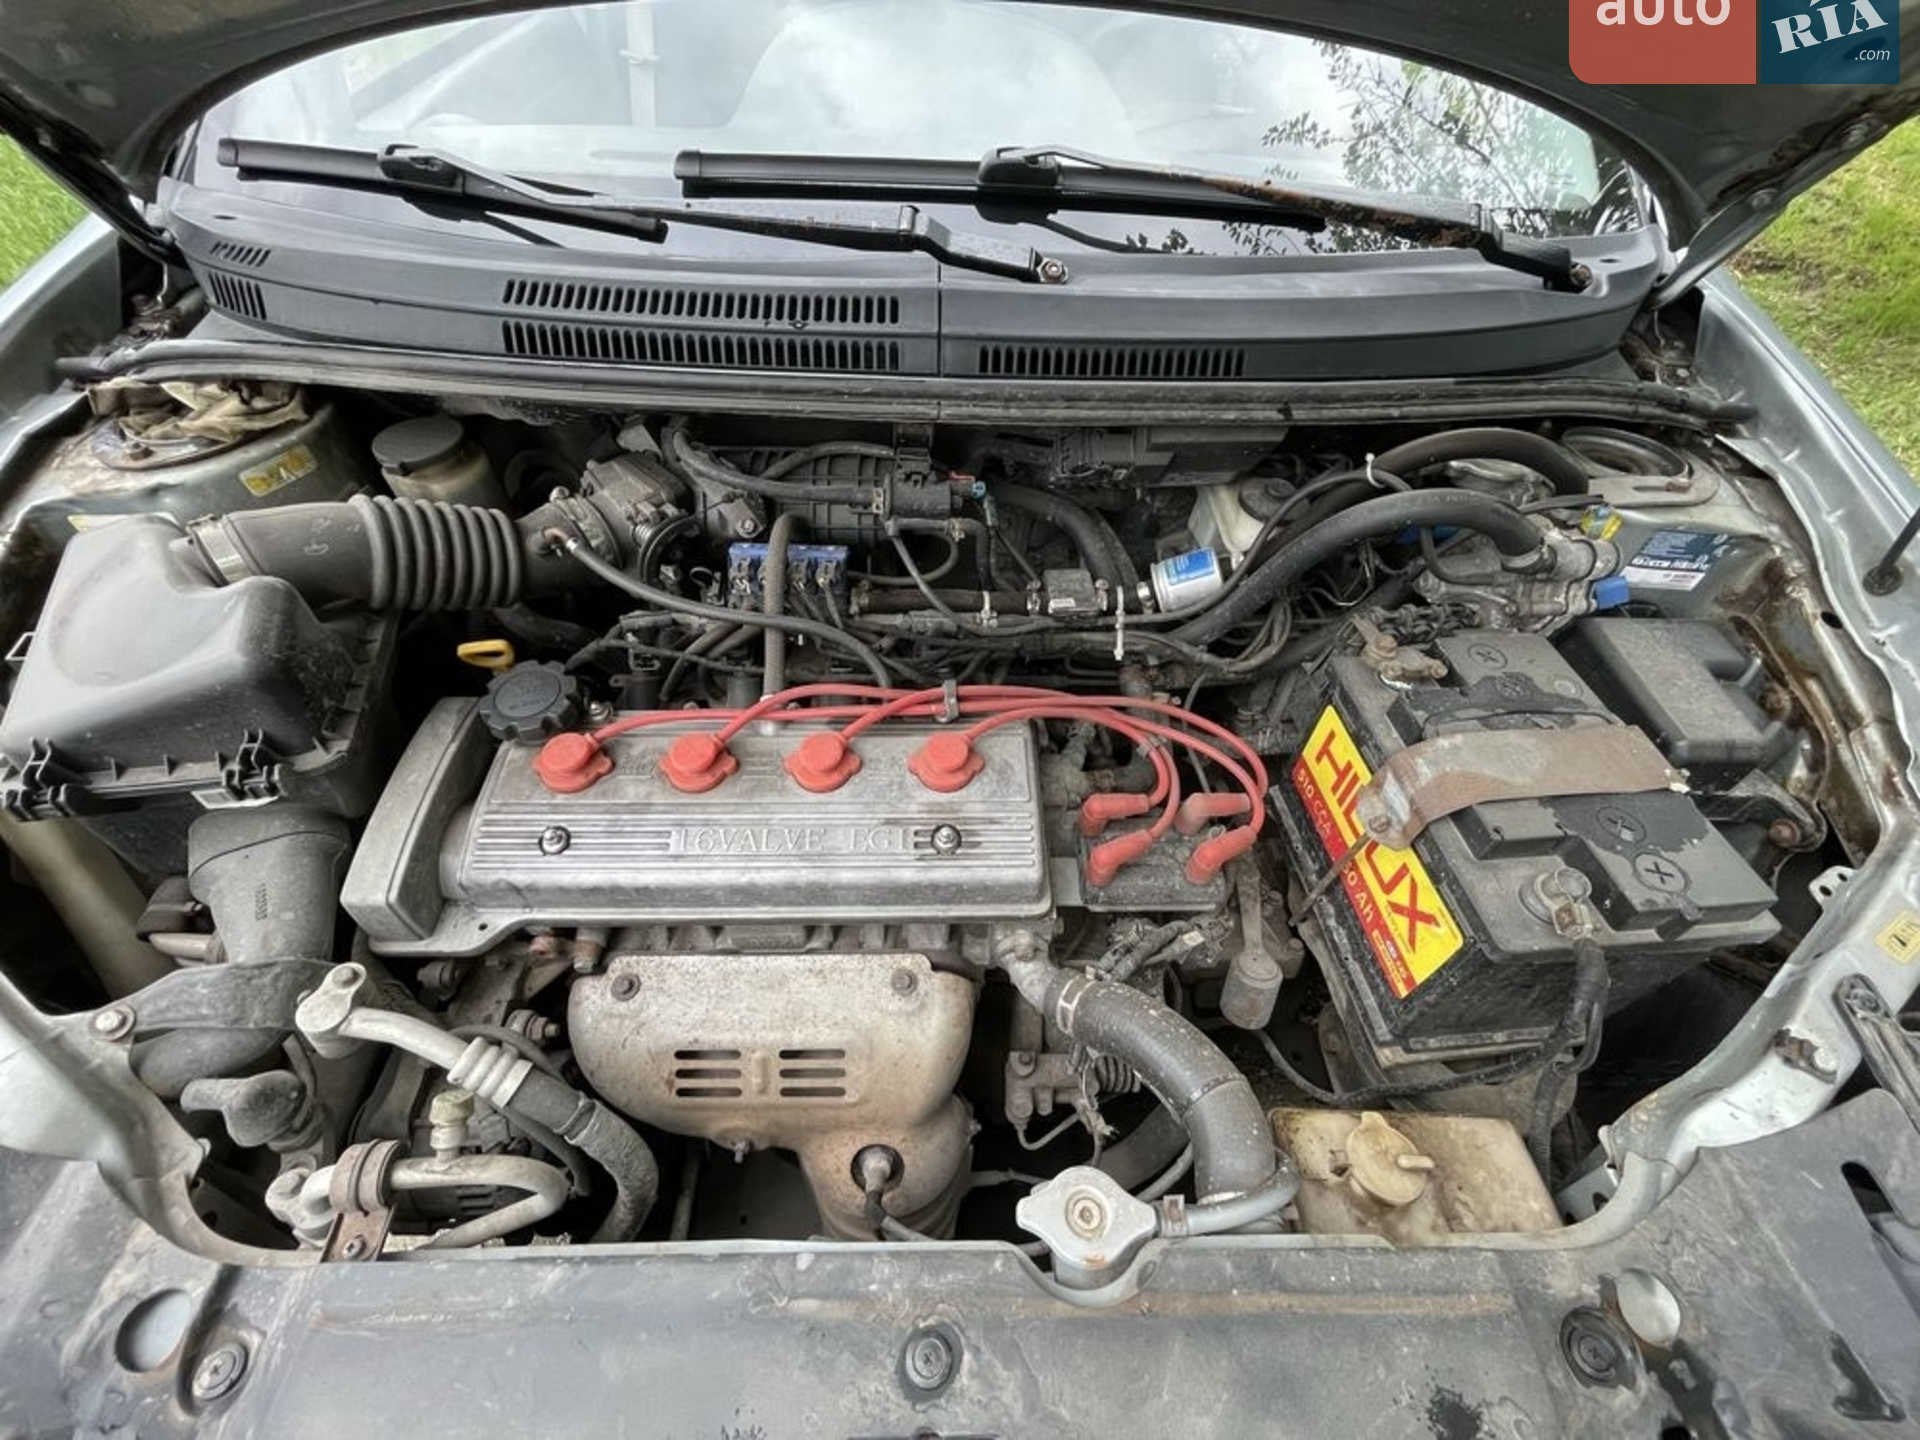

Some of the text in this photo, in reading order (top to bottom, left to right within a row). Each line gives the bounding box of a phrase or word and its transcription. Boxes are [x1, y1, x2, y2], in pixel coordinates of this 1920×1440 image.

[1298, 767, 1315, 799] 510
[1314, 801, 1333, 836] CCA
[1356, 892, 1375, 923] Ah
